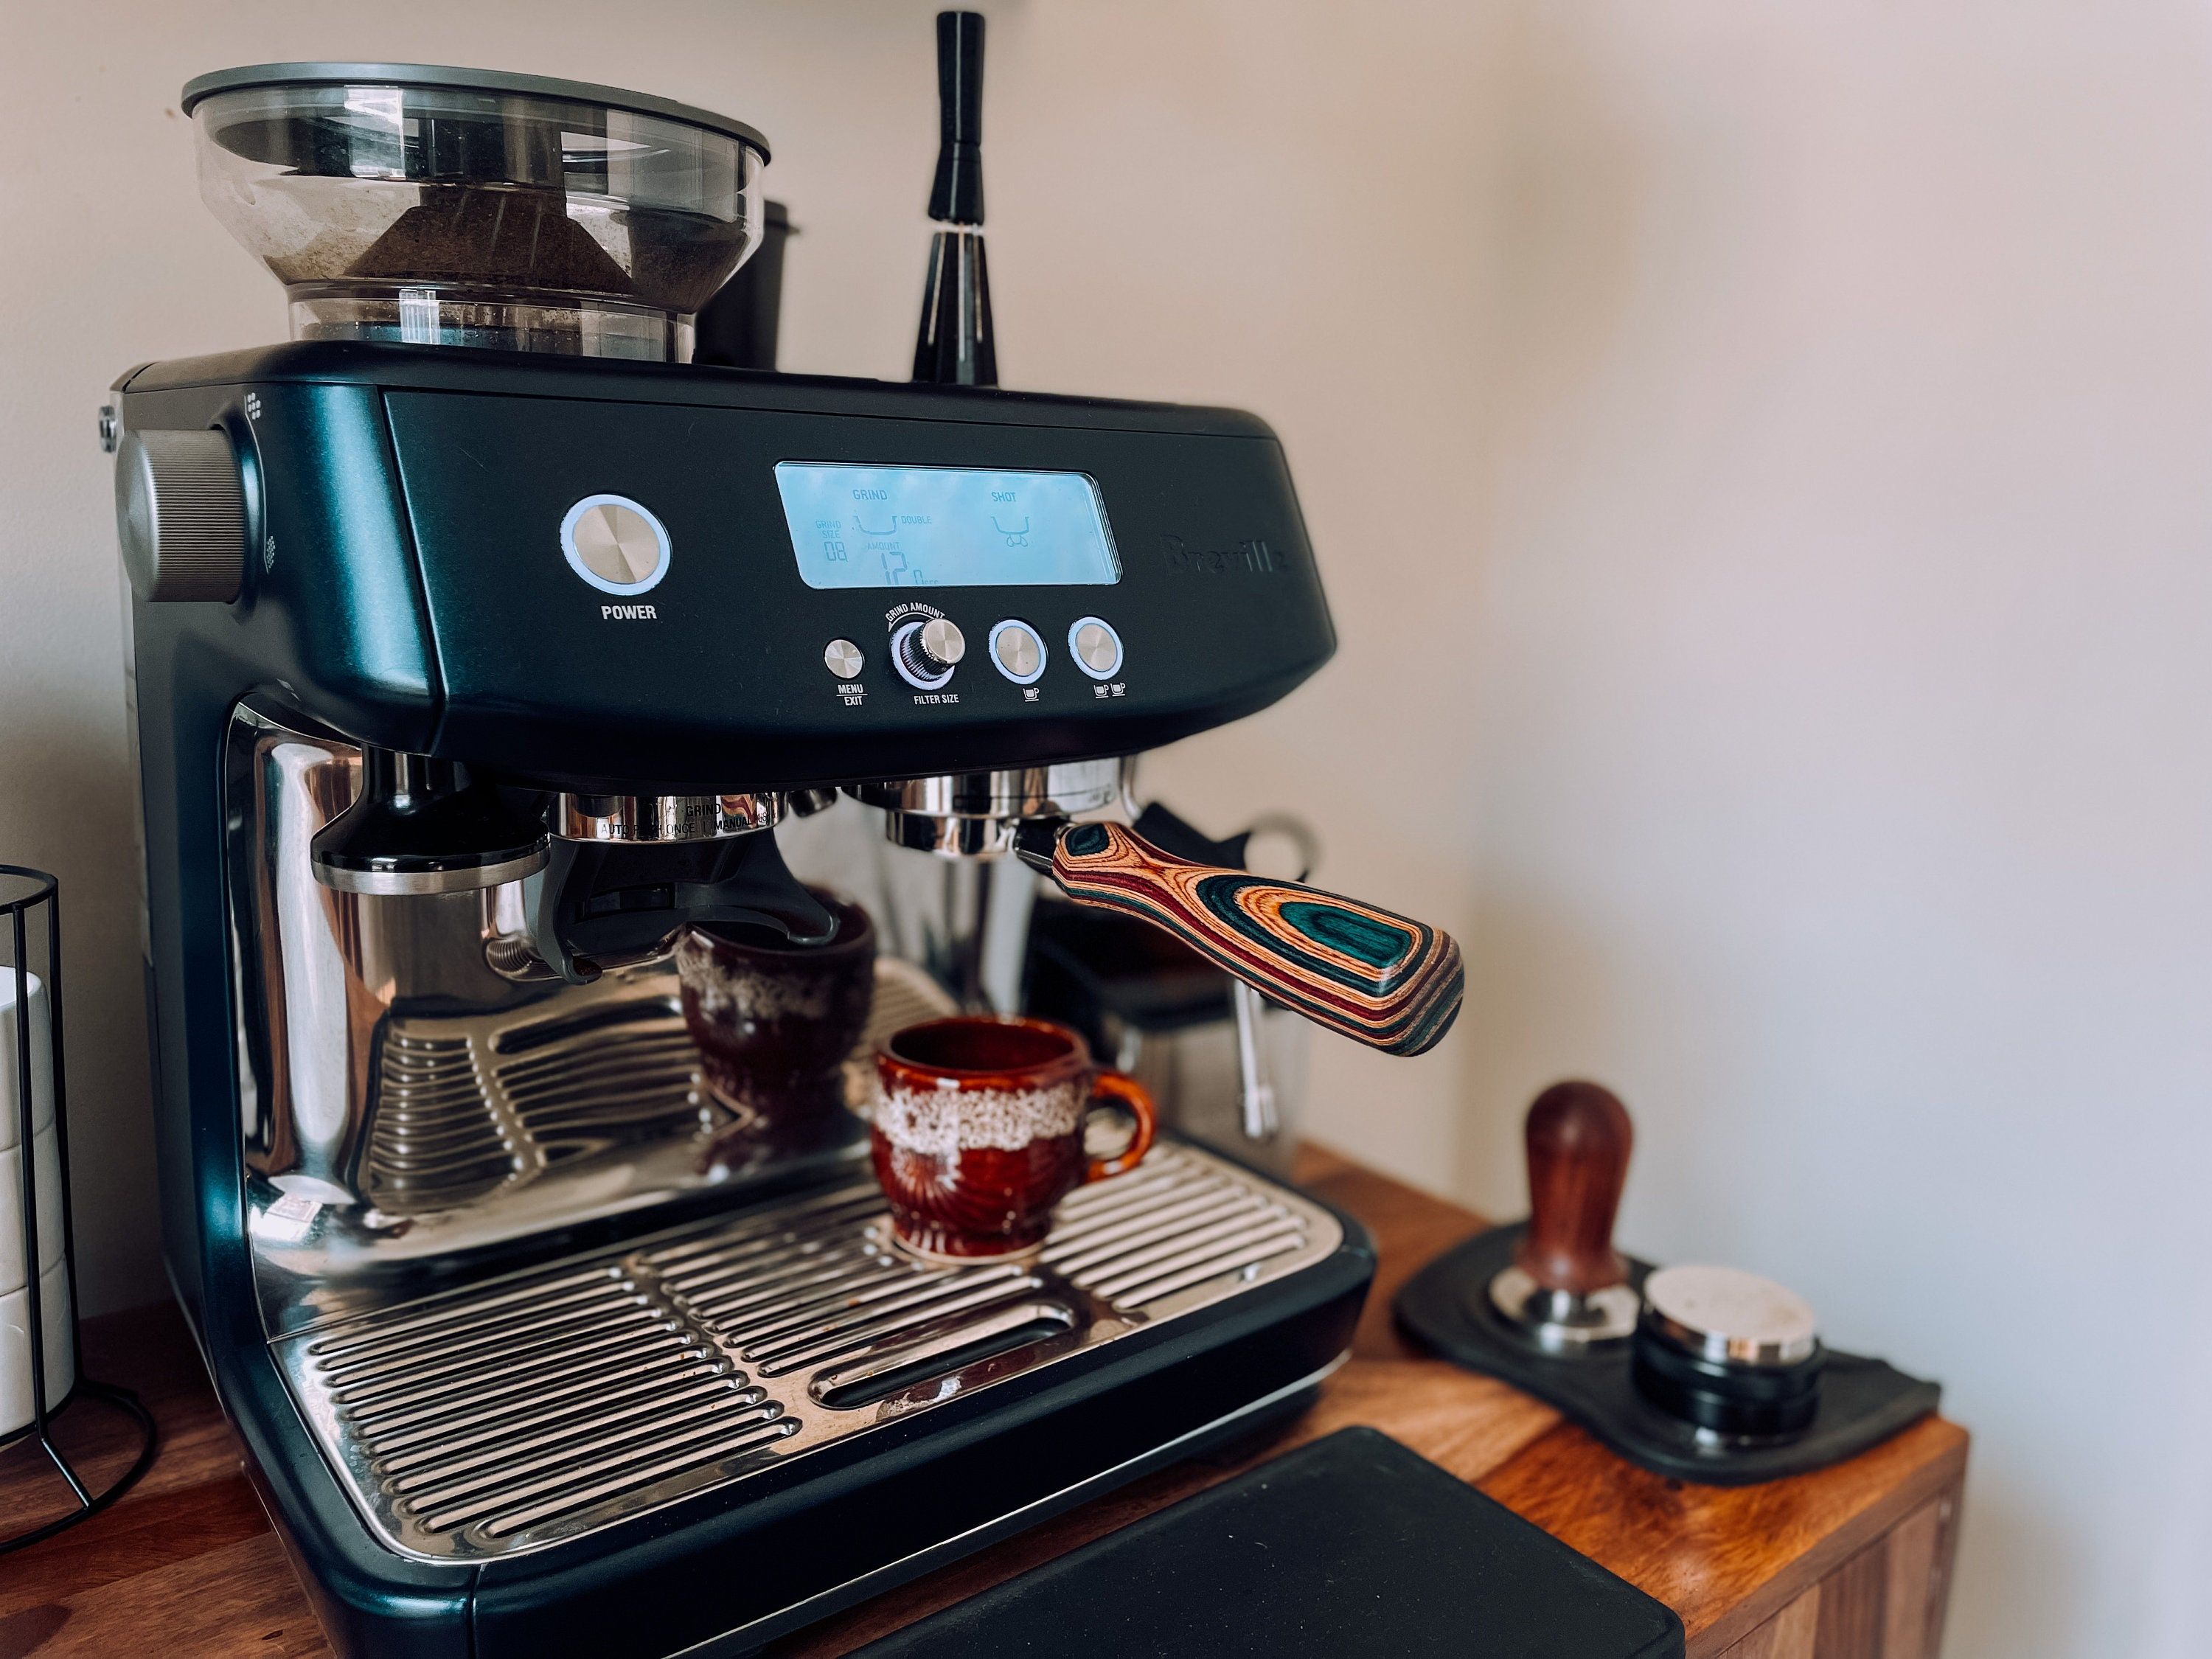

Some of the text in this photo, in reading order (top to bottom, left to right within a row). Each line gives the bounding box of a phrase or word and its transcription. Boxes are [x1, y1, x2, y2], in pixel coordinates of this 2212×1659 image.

[852, 489, 888, 501] GRIND
[991, 492, 1017, 503] SHOT
[815, 520, 842, 529] GRIND
[901, 515, 932, 524] DOUBLE
[821, 530, 841, 539] SIZE
[867, 541, 901, 551] AMOUNT
[600, 605, 658, 620] POWER
[885, 602, 945, 622] GRIND AMOUNT
[838, 684, 863, 694] MENU
[844, 695, 863, 706] EXIT
[914, 694, 960, 705] FILTER SIZE
[686, 803, 722, 817] GRIND
[600, 824, 630, 835] AUTO
[666, 822, 695, 835] ONCE
[715, 815, 752, 830] MANUAL
